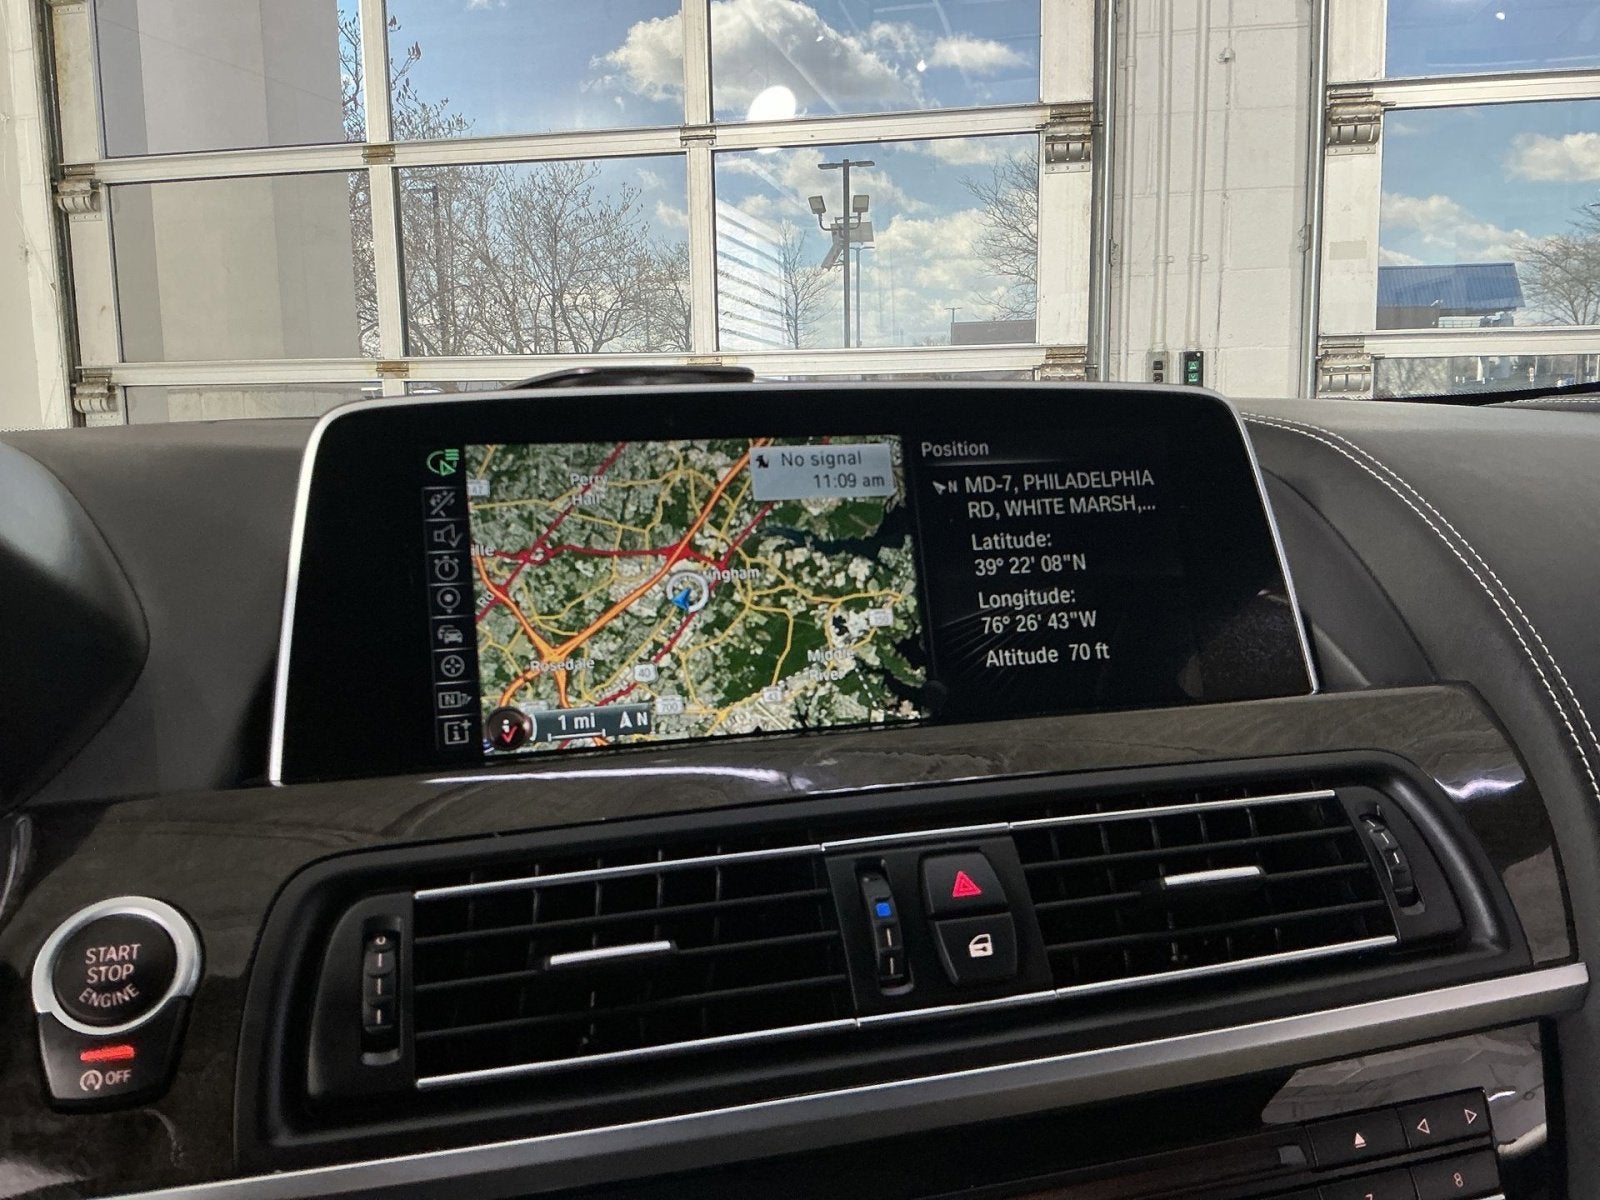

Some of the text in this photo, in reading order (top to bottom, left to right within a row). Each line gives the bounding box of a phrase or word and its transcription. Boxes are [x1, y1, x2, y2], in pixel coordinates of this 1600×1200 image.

[921, 440, 989, 457] Position
[781, 450, 862, 469] No signal
[813, 472, 885, 489] 11:09 am
[965, 475, 1019, 494] MD-7,
[1023, 469, 1155, 491] PHILADELPHIA
[967, 501, 1000, 520] RD,
[1004, 497, 1065, 518] WHITE
[971, 531, 1052, 551] Latitude:
[974, 557, 1004, 576] 39°
[1009, 556, 1036, 575] 22'
[978, 587, 1076, 611] Longitude:
[981, 615, 1011, 635] 76°
[1015, 614, 1042, 633] 26'
[986, 642, 1111, 668] Altitude 70 ft
[529, 658, 596, 673] Rosedale
[558, 714, 567, 730] 1
[573, 712, 596, 730] mi
[85, 944, 141, 964] START
[87, 964, 135, 984] STOP
[78, 983, 140, 1008] ENGINE
[105, 1069, 132, 1085] OFF
[1453, 1172, 1464, 1188] 8
